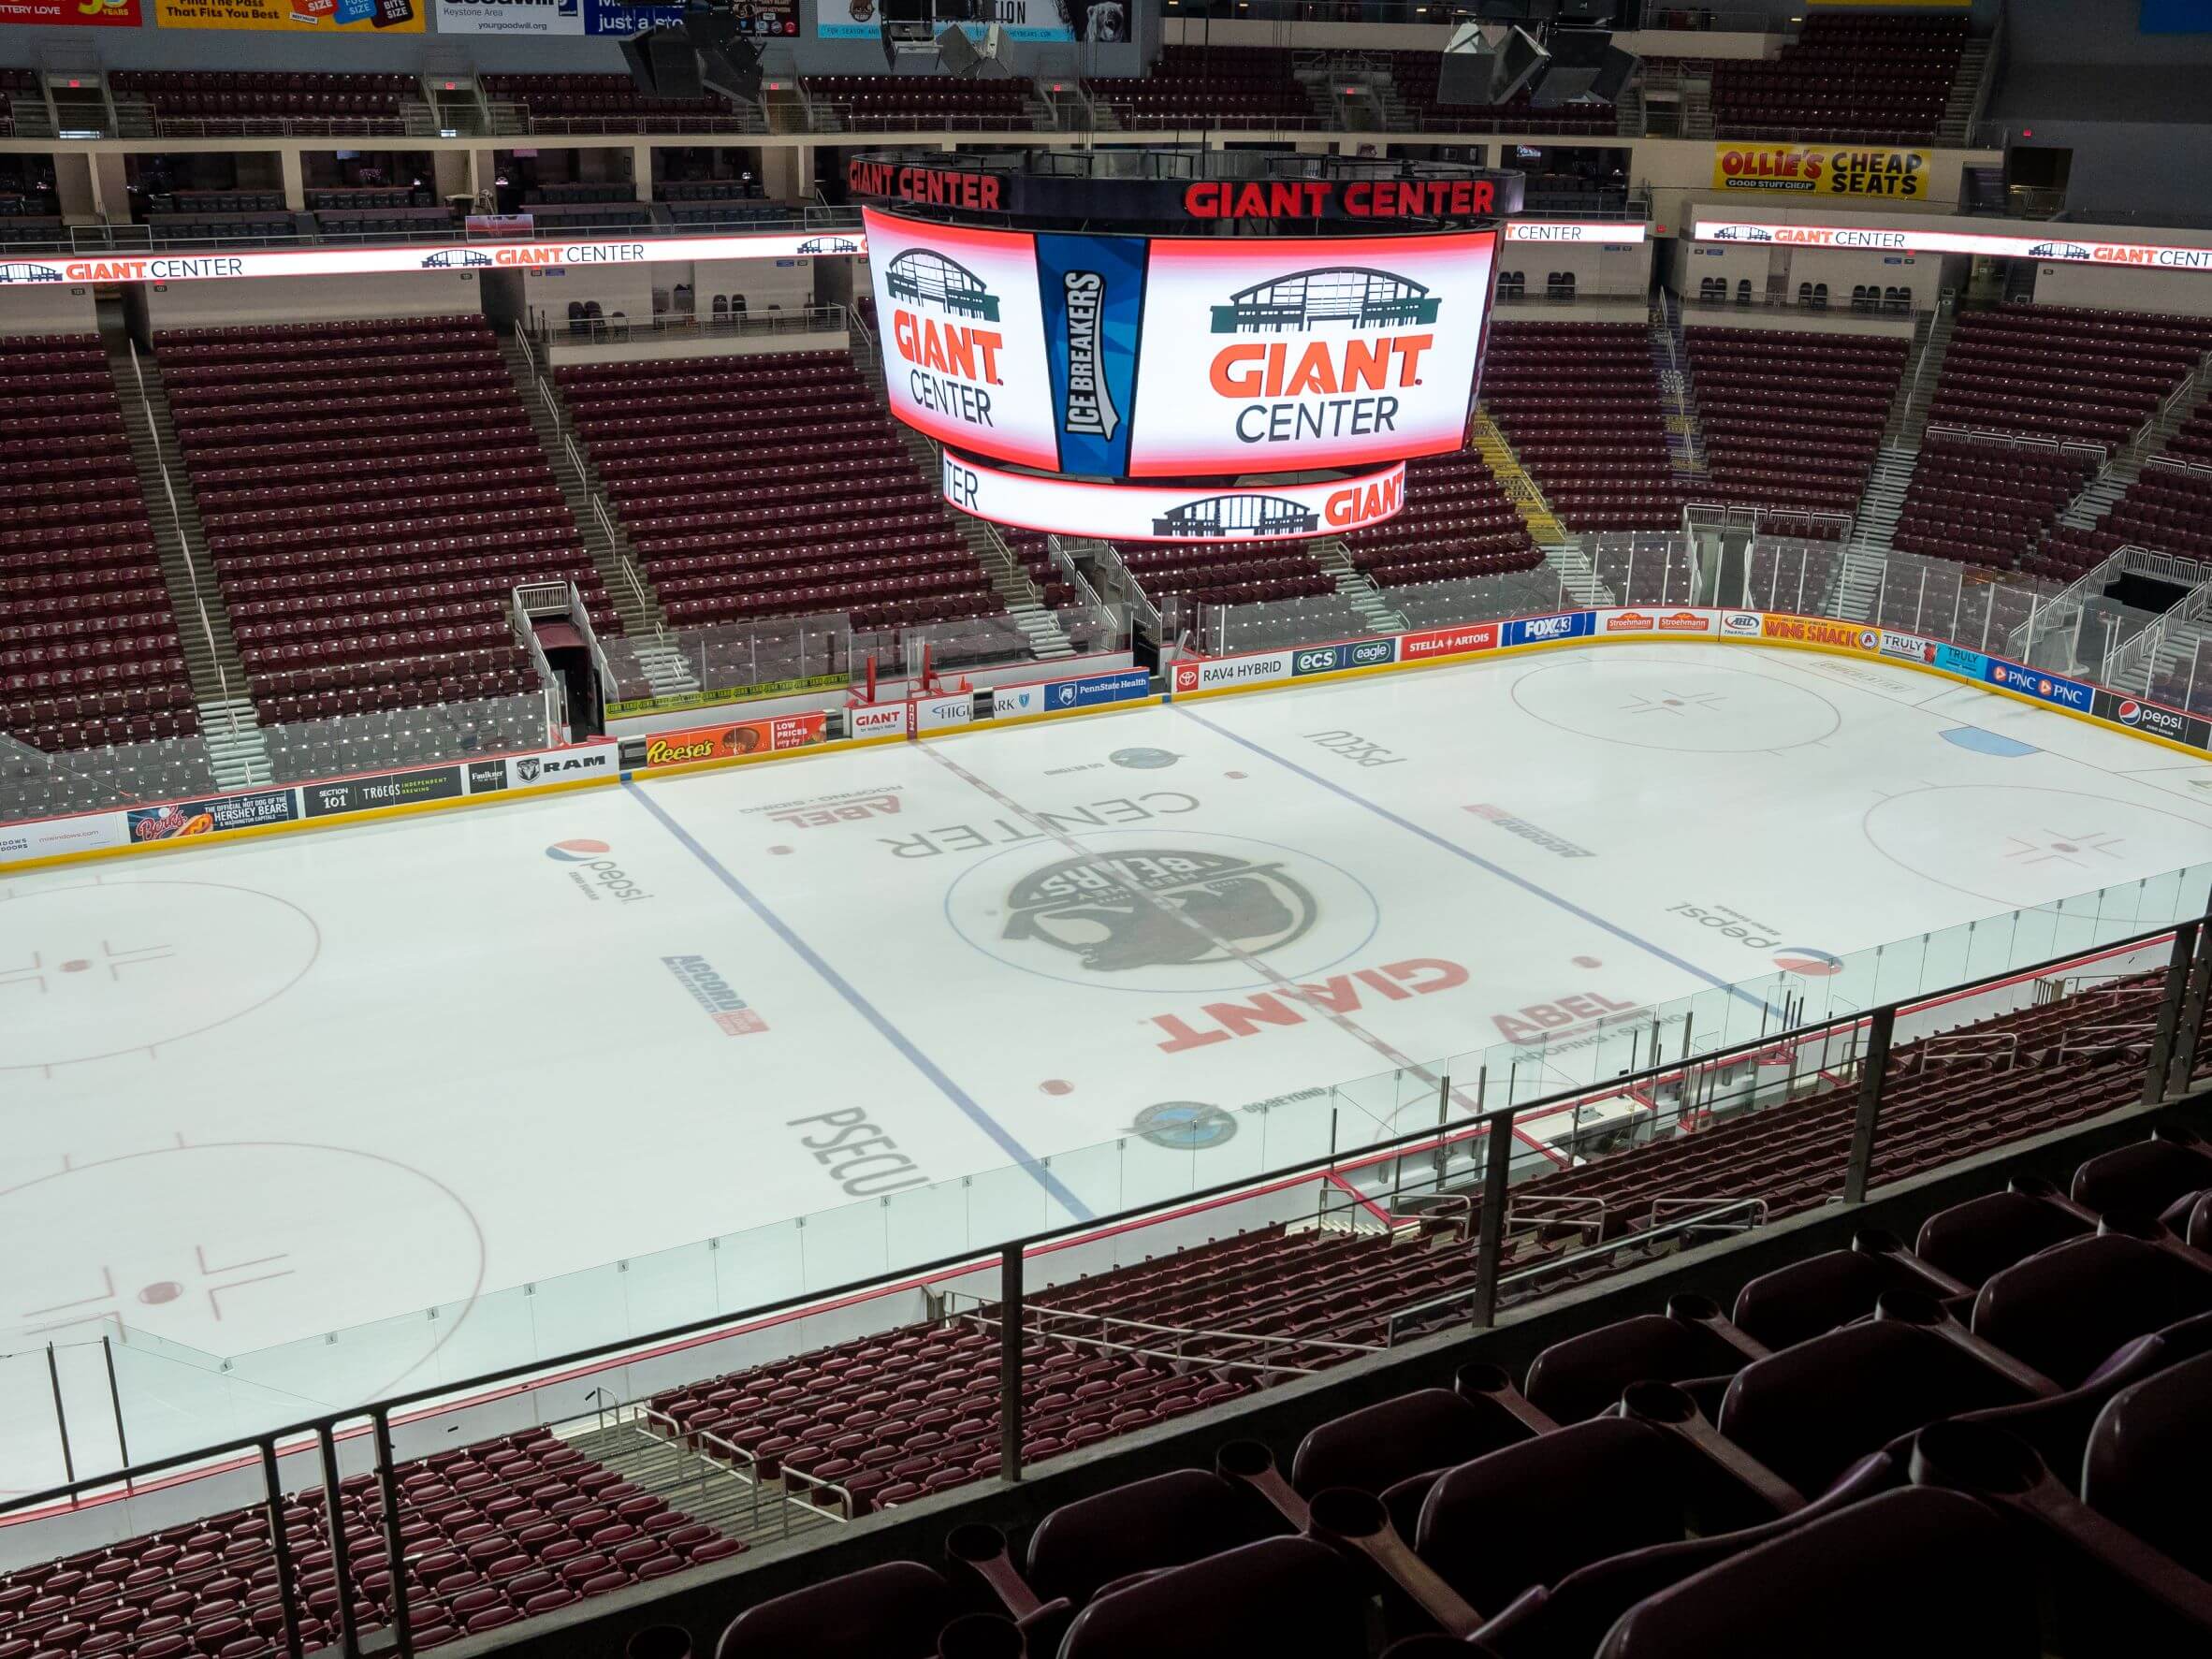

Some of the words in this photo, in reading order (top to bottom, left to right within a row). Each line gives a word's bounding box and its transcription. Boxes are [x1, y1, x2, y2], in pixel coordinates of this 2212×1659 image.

[35, 6, 61, 15] LOVE
[167, 7, 196, 18] That
[199, 7, 223, 18] Fits
[226, 8, 248, 19] You
[251, 9, 280, 20] Best
[444, 7, 482, 17] Keystone
[485, 7, 503, 17] Area
[478, 22, 547, 32] yourgoodwill.org
[598, 13, 633, 33] just
[638, 18, 649, 30] a
[1831, 151, 1922, 174] CHEAP
[850, 160, 894, 196] GIANT
[899, 168, 999, 211] CENTER
[1728, 179, 1757, 187] GOOD
[1758, 180, 1783, 189] STUFF
[1783, 181, 1813, 190] CHEAP
[1831, 172, 1918, 195] SEATS
[1185, 182, 1333, 218] GIANT
[1344, 181, 1494, 217] CENTER
[1518, 226, 1581, 240] CENTER
[1774, 228, 1834, 244] GIANT
[1836, 231, 1905, 248] CENTER
[496, 248, 564, 266] GIANT
[567, 244, 645, 263] CENTER
[2093, 247, 2159, 265] GIANT
[65, 262, 147, 280] GIANT
[151, 258, 243, 278] CENTER
[1065, 272, 1101, 392] BREAKERS
[894, 309, 1002, 386] GIANT
[1208, 334, 1434, 399] GIANT
[910, 369, 994, 428] CENTER
[1067, 394, 1105, 434] ICE
[1235, 396, 1400, 444] CENTER
[1608, 618, 1652, 628] Stroehmann
[1661, 618, 1706, 628] Stroehmann
[1731, 617, 1754, 627] AHL
[1409, 639, 1445, 652] STELLA
[1454, 633, 1490, 646] ARTOIS
[1765, 620, 1805, 640] WING
[1808, 626, 1857, 648] SHACK
[1884, 635, 1923, 651] TRULY
[1299, 651, 1334, 669] ecs
[1356, 645, 1388, 662] eagle
[1948, 648, 1980, 664] TRULY
[1203, 668, 1235, 682] RAV4
[1237, 662, 1283, 677] HYBRID
[1121, 678, 1146, 689] Health
[2007, 673, 2038, 691] PNC
[2054, 686, 2084, 705] PNC
[856, 711, 900, 726] GIANT
[941, 705, 971, 719] HIG
[2141, 708, 2183, 730] pepsi
[777, 721, 796, 731] LOW
[777, 727, 808, 738] PRICES
[647, 739, 716, 764] Reese's
[1302, 731, 1408, 767] PSECU
[544, 755, 605, 773] RAM
[401, 777, 447, 788] INDEPENDENT
[471, 769, 503, 780] Faulkner
[319, 788, 349, 798] SECTION
[323, 796, 346, 809] 101
[214, 807, 258, 822] HERSHEY
[258, 803, 288, 815] BEARS
[216, 803, 241, 812] OFFICIAL
[255, 798, 267, 807] DOG
[767, 794, 902, 829] ABEL
[876, 792, 1201, 860] CENTER
[1, 843, 29, 852] DOORS
[579, 861, 655, 903] pepsi
[1040, 855, 1202, 896] BEARS
[1665, 901, 1783, 950] pepsi
[1150, 958, 1470, 1055] GIANT
[1491, 993, 1637, 1046] ABEL
[786, 1106, 930, 1197] PSECU
